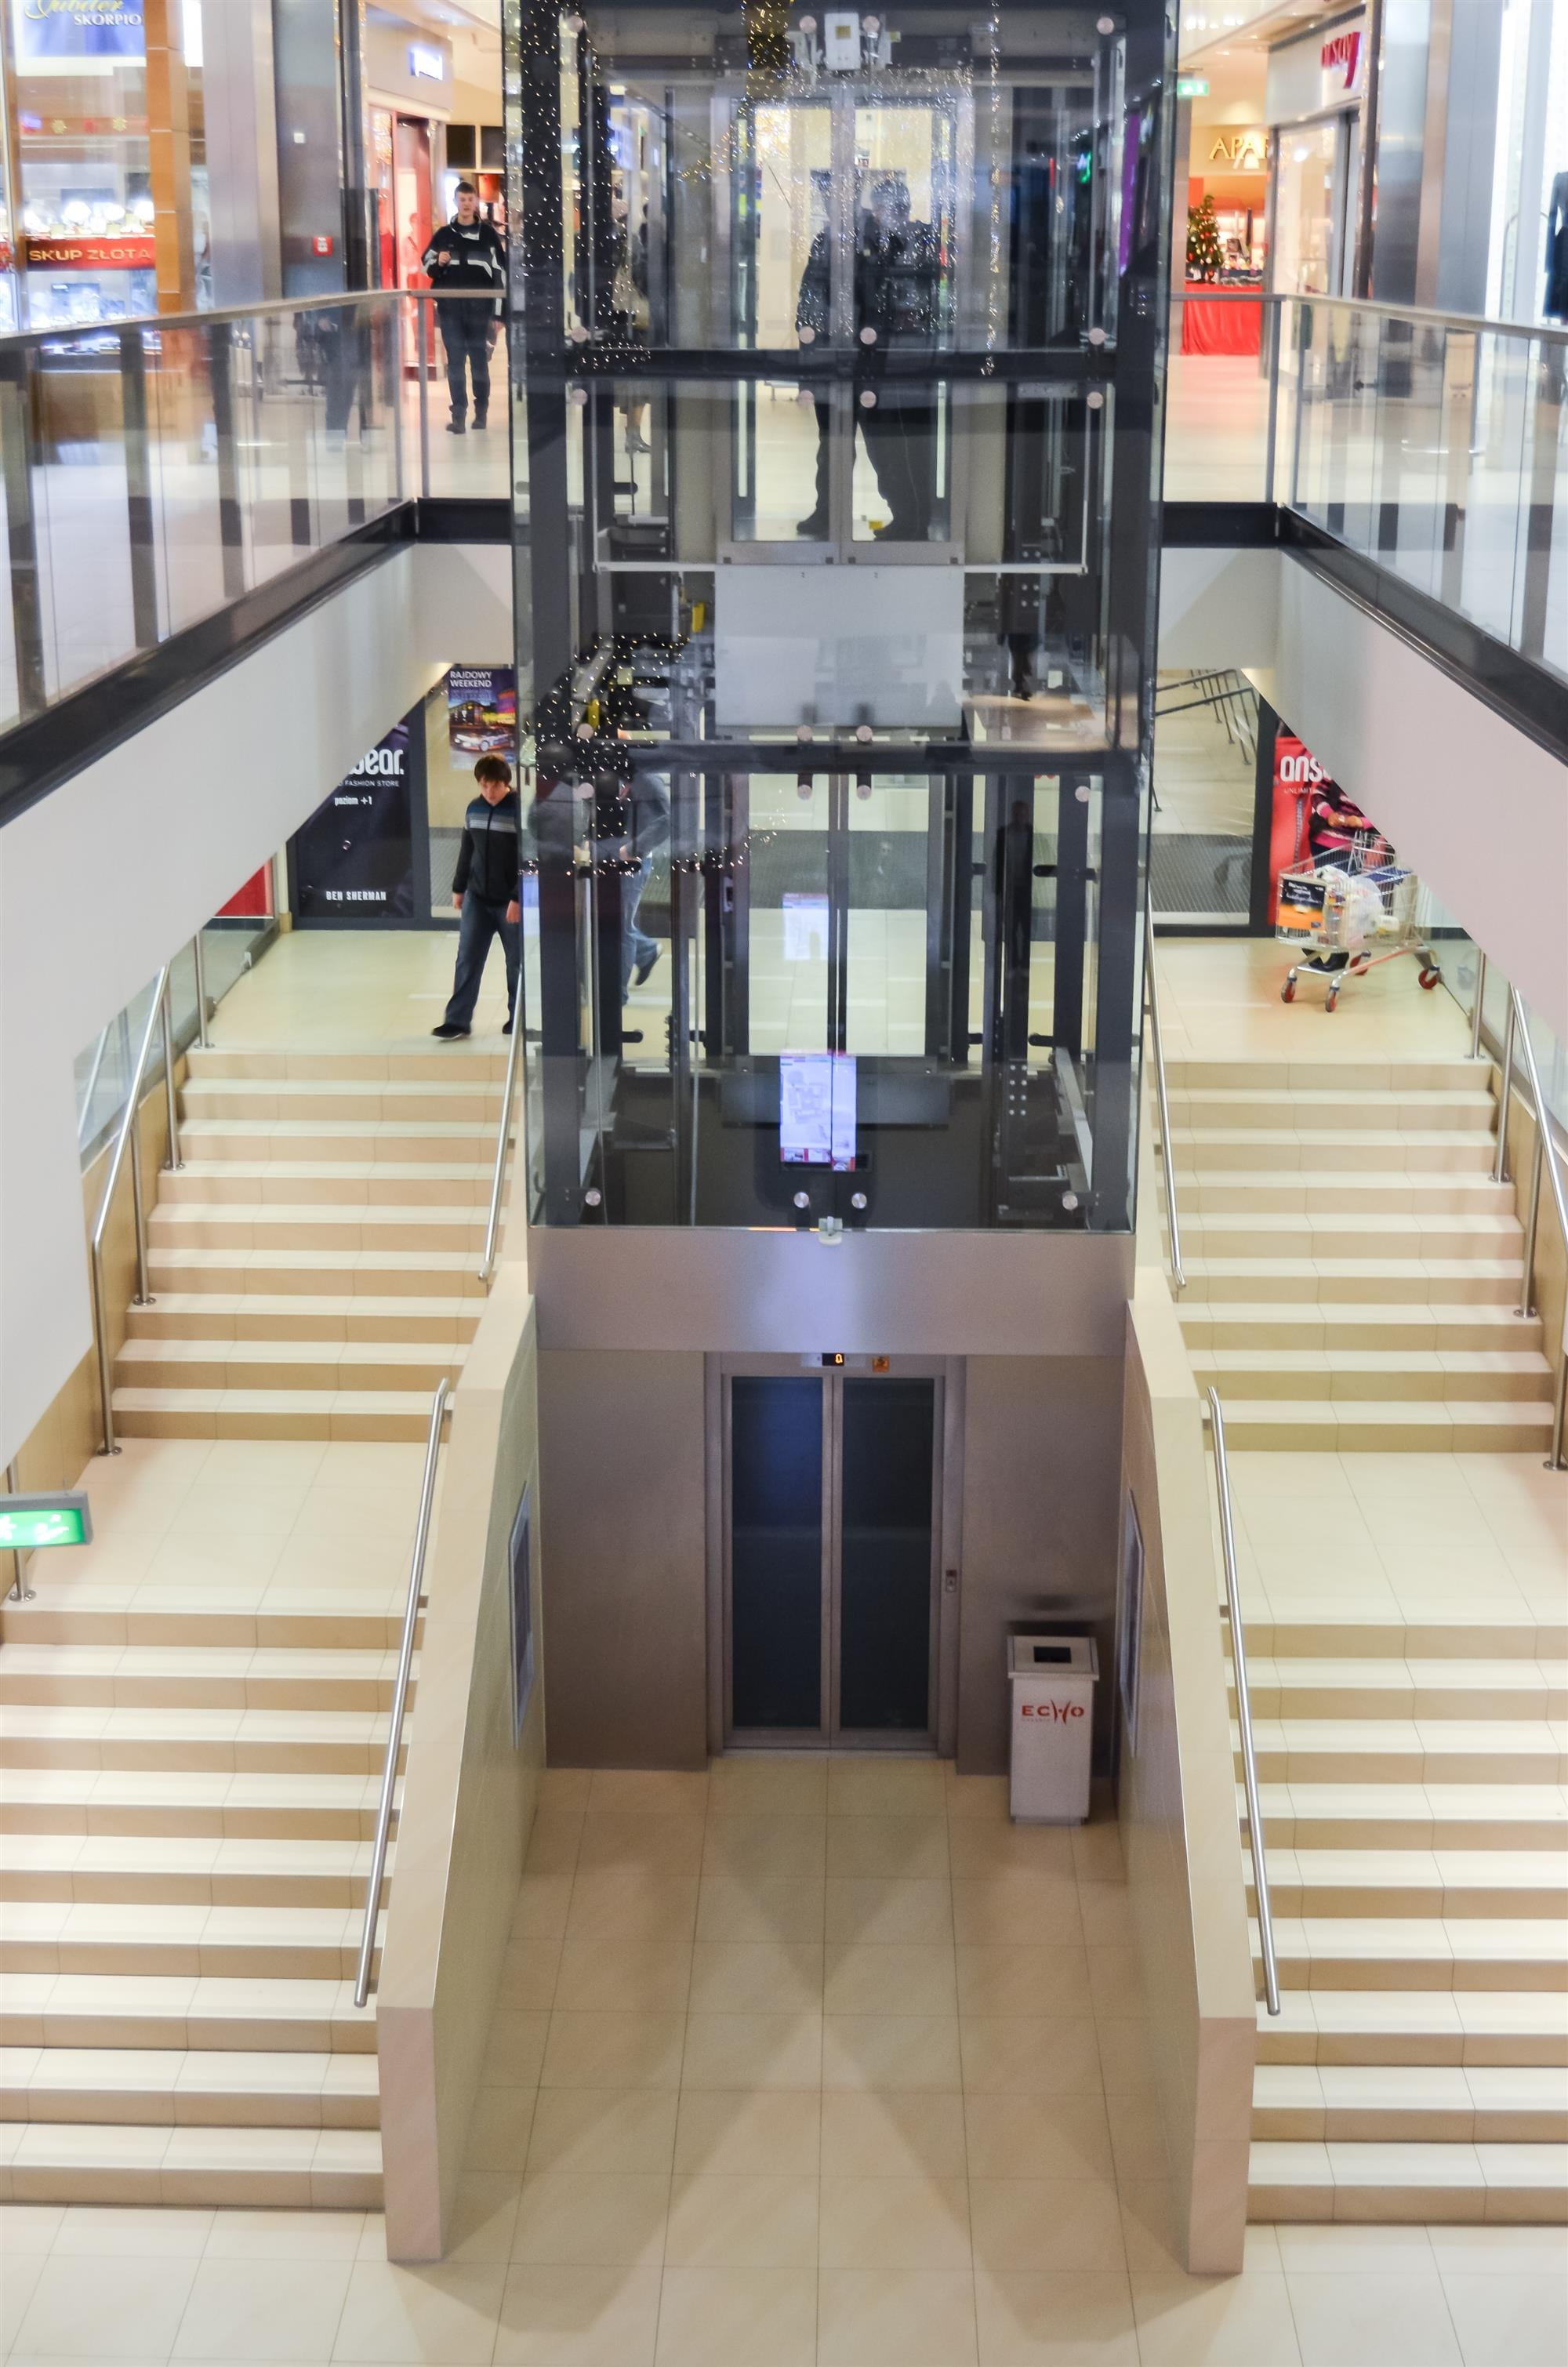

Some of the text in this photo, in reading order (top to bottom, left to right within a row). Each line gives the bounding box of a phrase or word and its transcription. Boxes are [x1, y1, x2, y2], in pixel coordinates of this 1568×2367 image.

[29, 249, 83, 262] SKUP
[449, 670, 492, 680] RAJDOWY
[449, 679, 492, 688] WEEKEND
[1280, 755, 1331, 782] ans
[361, 796, 372, 805] +1
[325, 891, 387, 901] BEN SHERMAN
